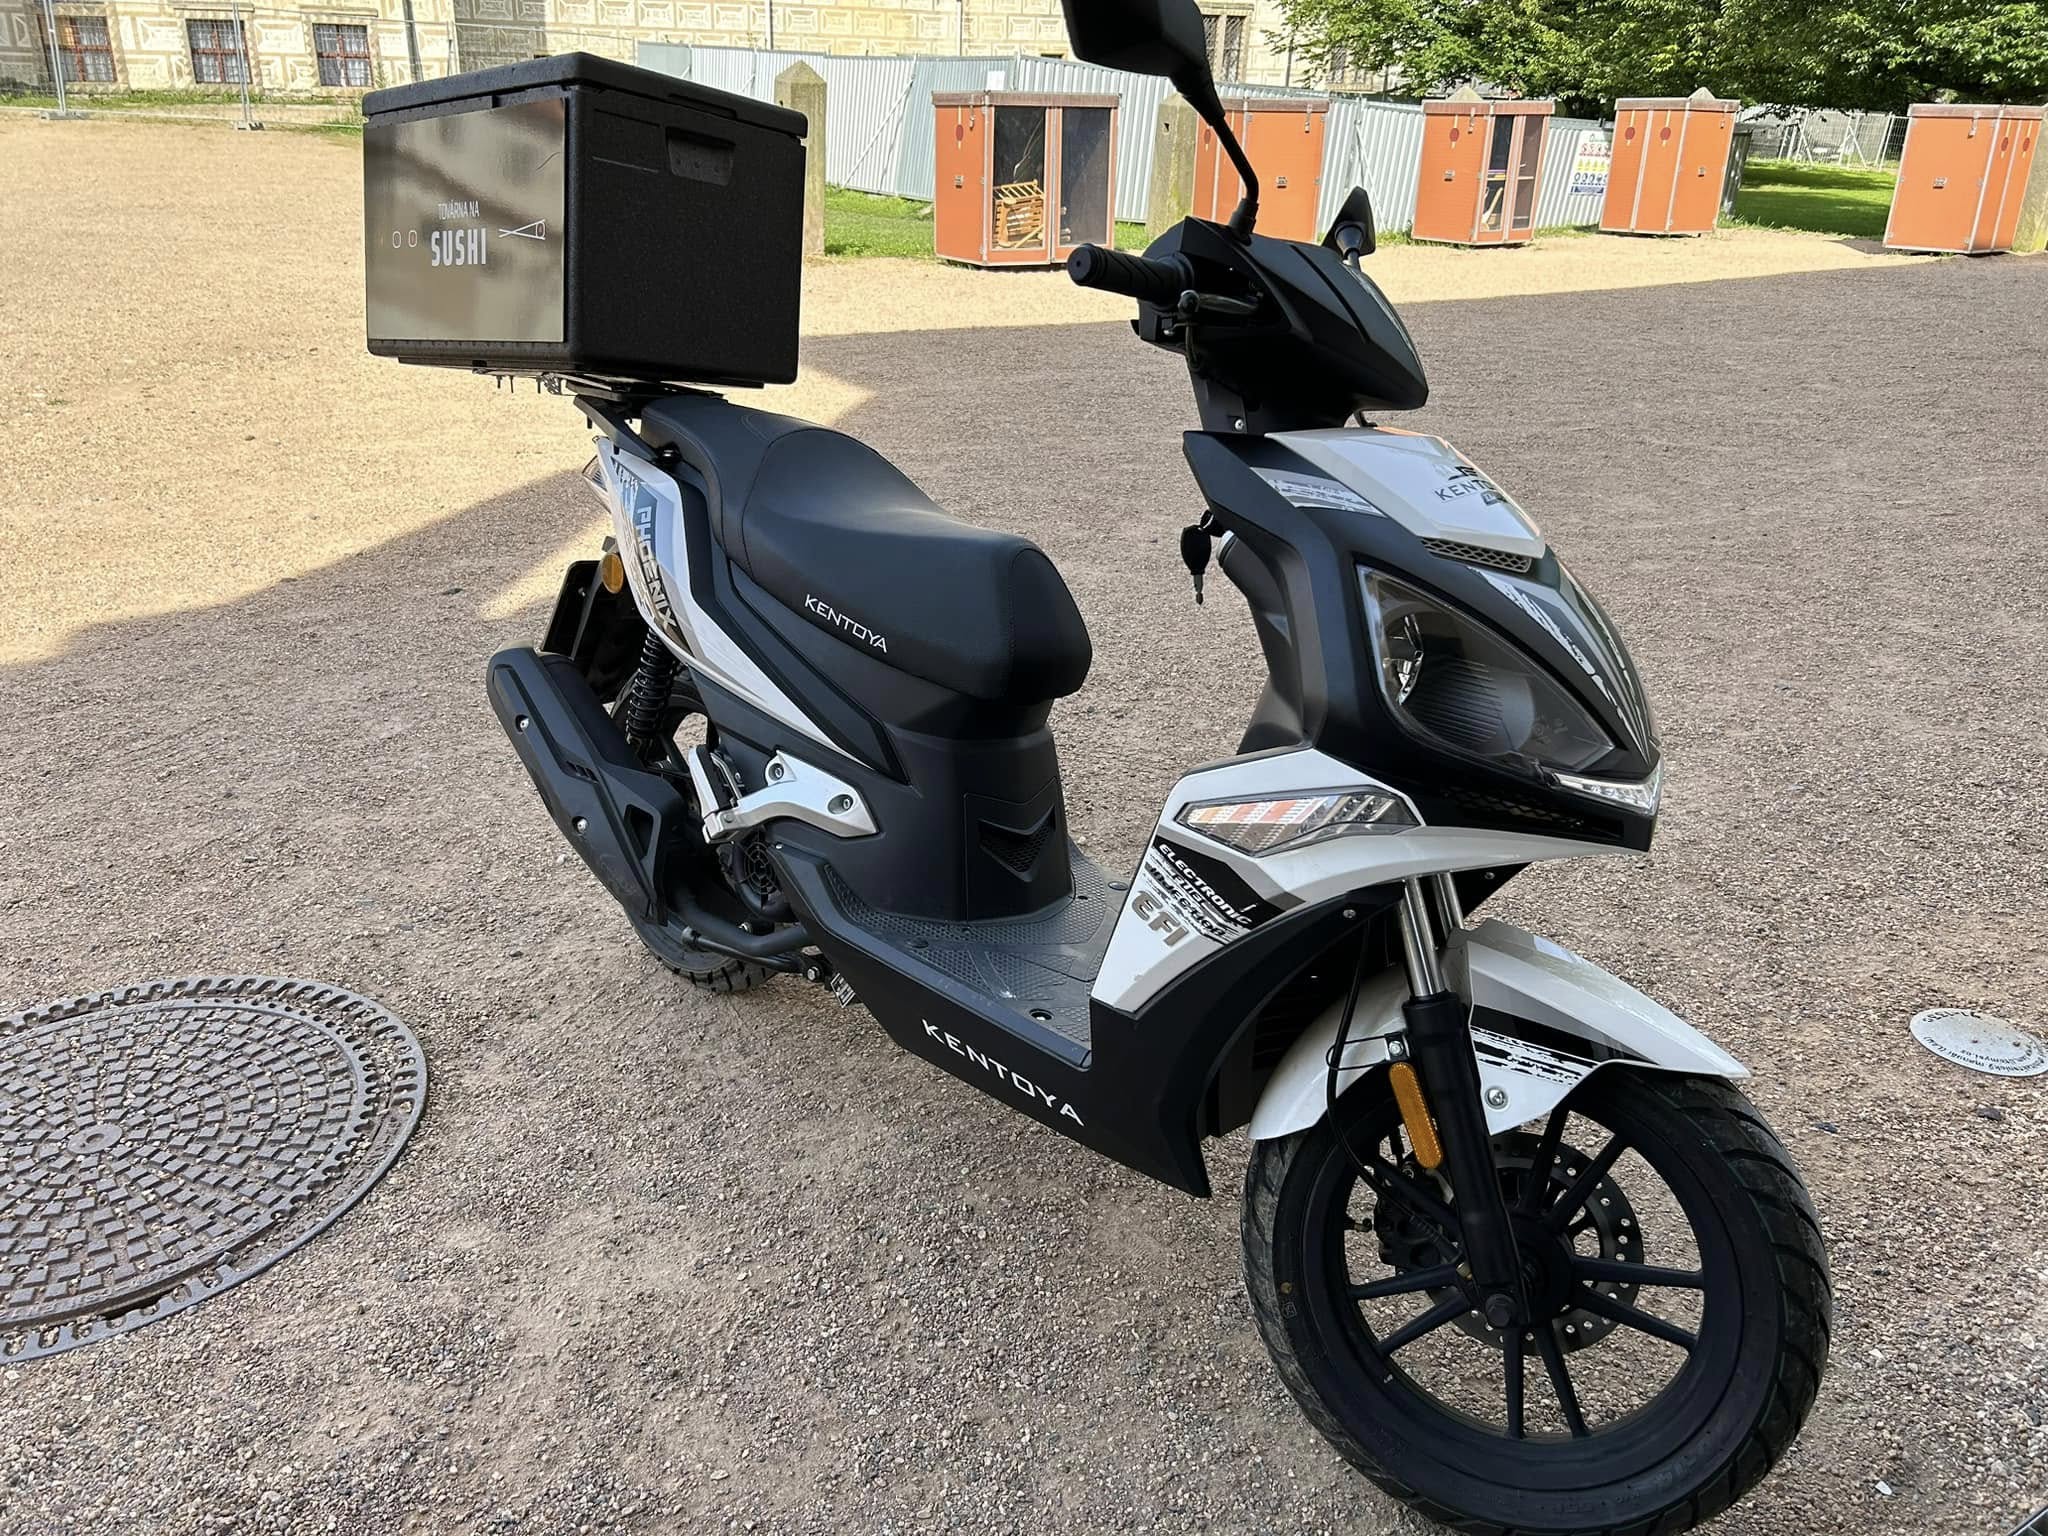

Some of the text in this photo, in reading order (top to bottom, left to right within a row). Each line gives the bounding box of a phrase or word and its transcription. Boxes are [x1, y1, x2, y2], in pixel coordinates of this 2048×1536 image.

[438, 200, 480, 220] TOVÁRNA NA
[431, 228, 487, 266] SUSHI
[636, 506, 678, 629] PHOENIX
[804, 594, 888, 653] KENTOYA
[1158, 843, 1253, 925] ELECTRONIC
[1131, 890, 1190, 947] EFI
[922, 1019, 1085, 1127] KENTOYA
